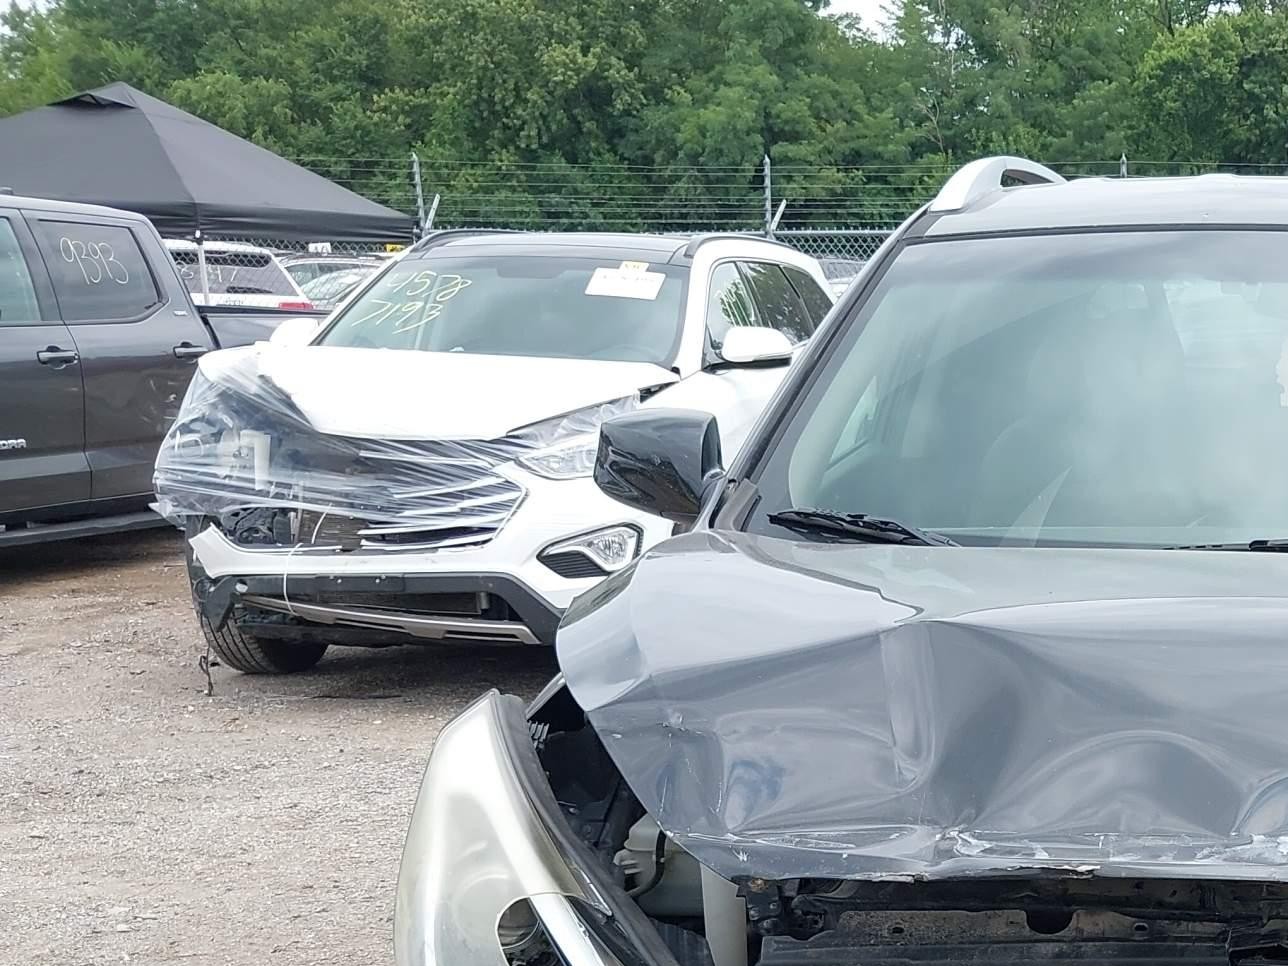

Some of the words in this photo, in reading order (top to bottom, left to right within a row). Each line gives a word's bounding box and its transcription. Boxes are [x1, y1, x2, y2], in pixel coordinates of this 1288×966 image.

[59, 236, 129, 285] 9393
[386, 270, 473, 302] 4578
[351, 299, 444, 335] 7193
